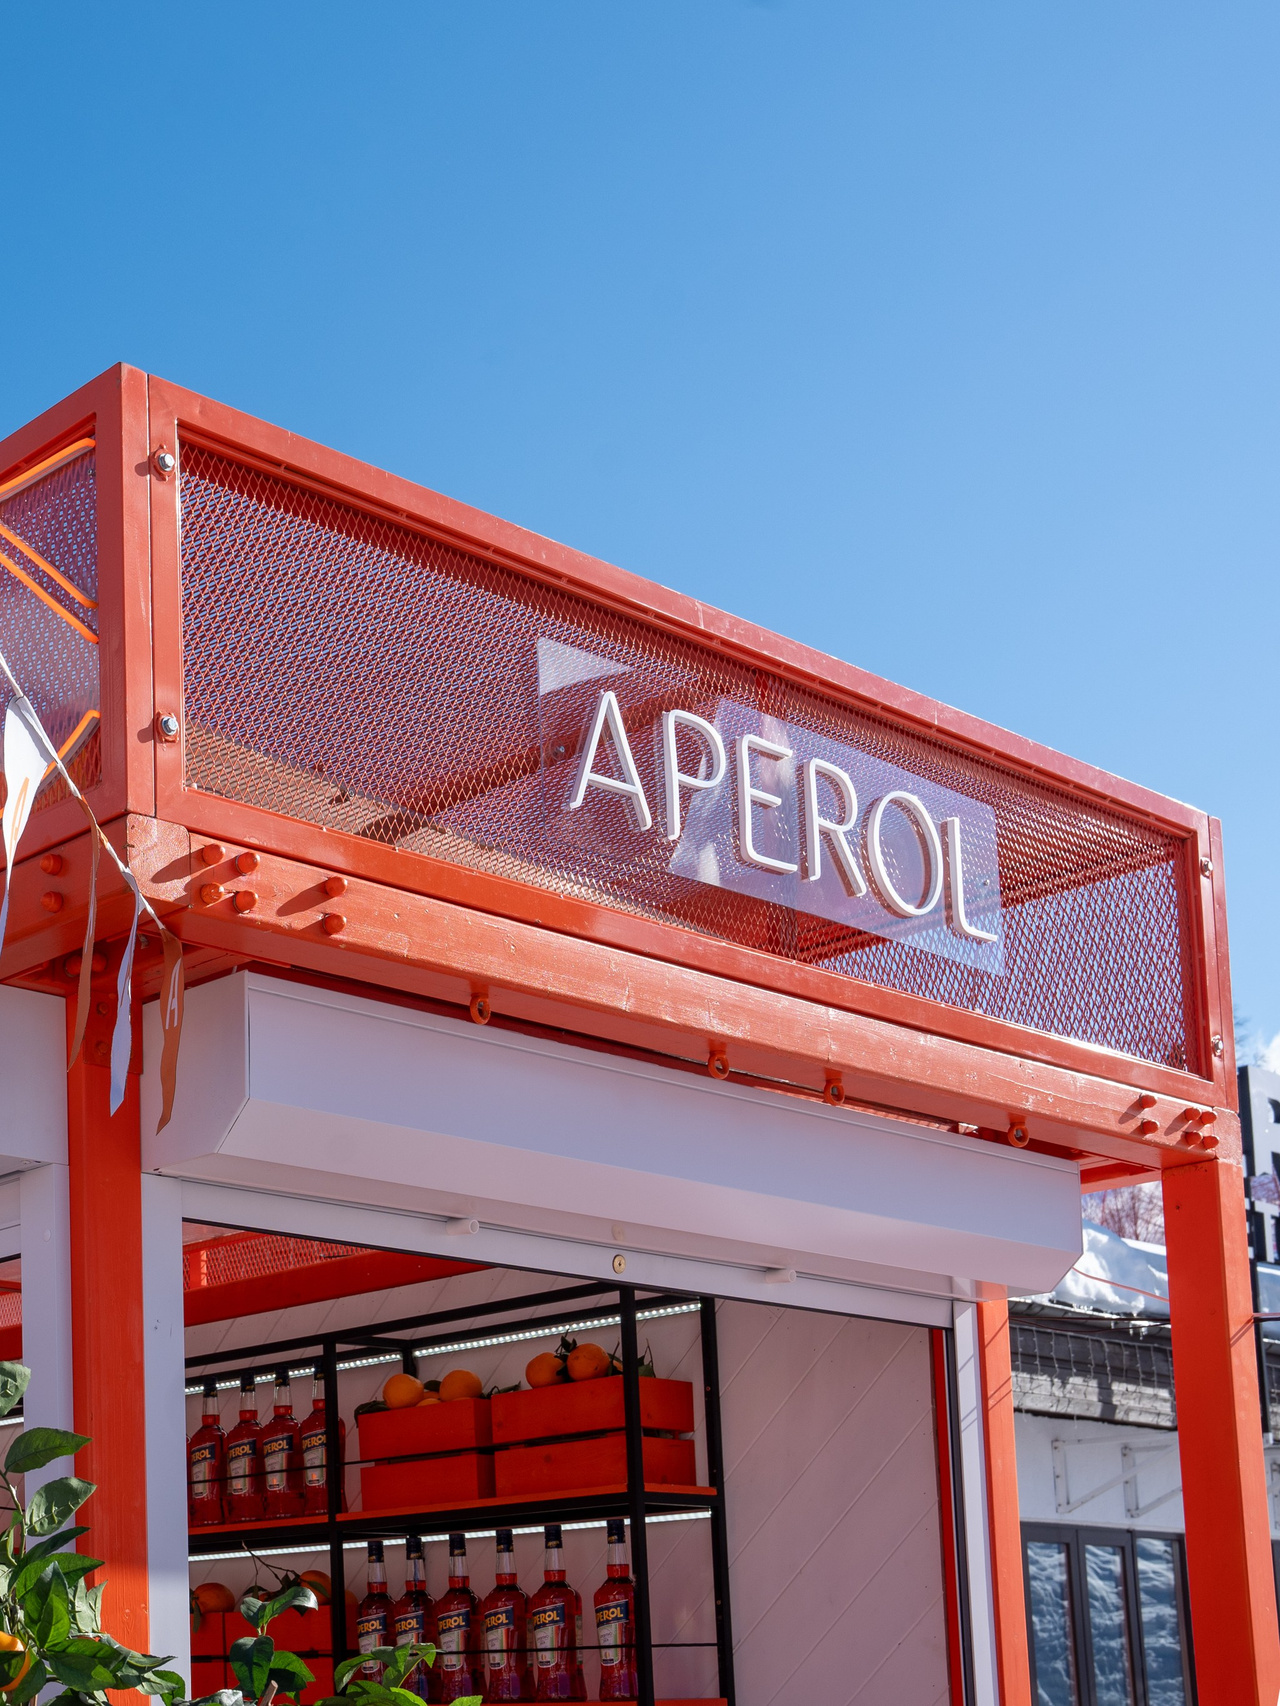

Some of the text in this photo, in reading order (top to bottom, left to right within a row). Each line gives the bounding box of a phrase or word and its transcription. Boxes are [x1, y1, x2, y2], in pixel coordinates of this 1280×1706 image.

[568, 690, 999, 944] APEROL
[263, 1438, 289, 1456] PEROL
[438, 1615, 466, 1631] PEROL
[533, 1610, 560, 1626] PEROL
[596, 1607, 624, 1625] PEROL
[357, 1619, 383, 1634] PEROL
